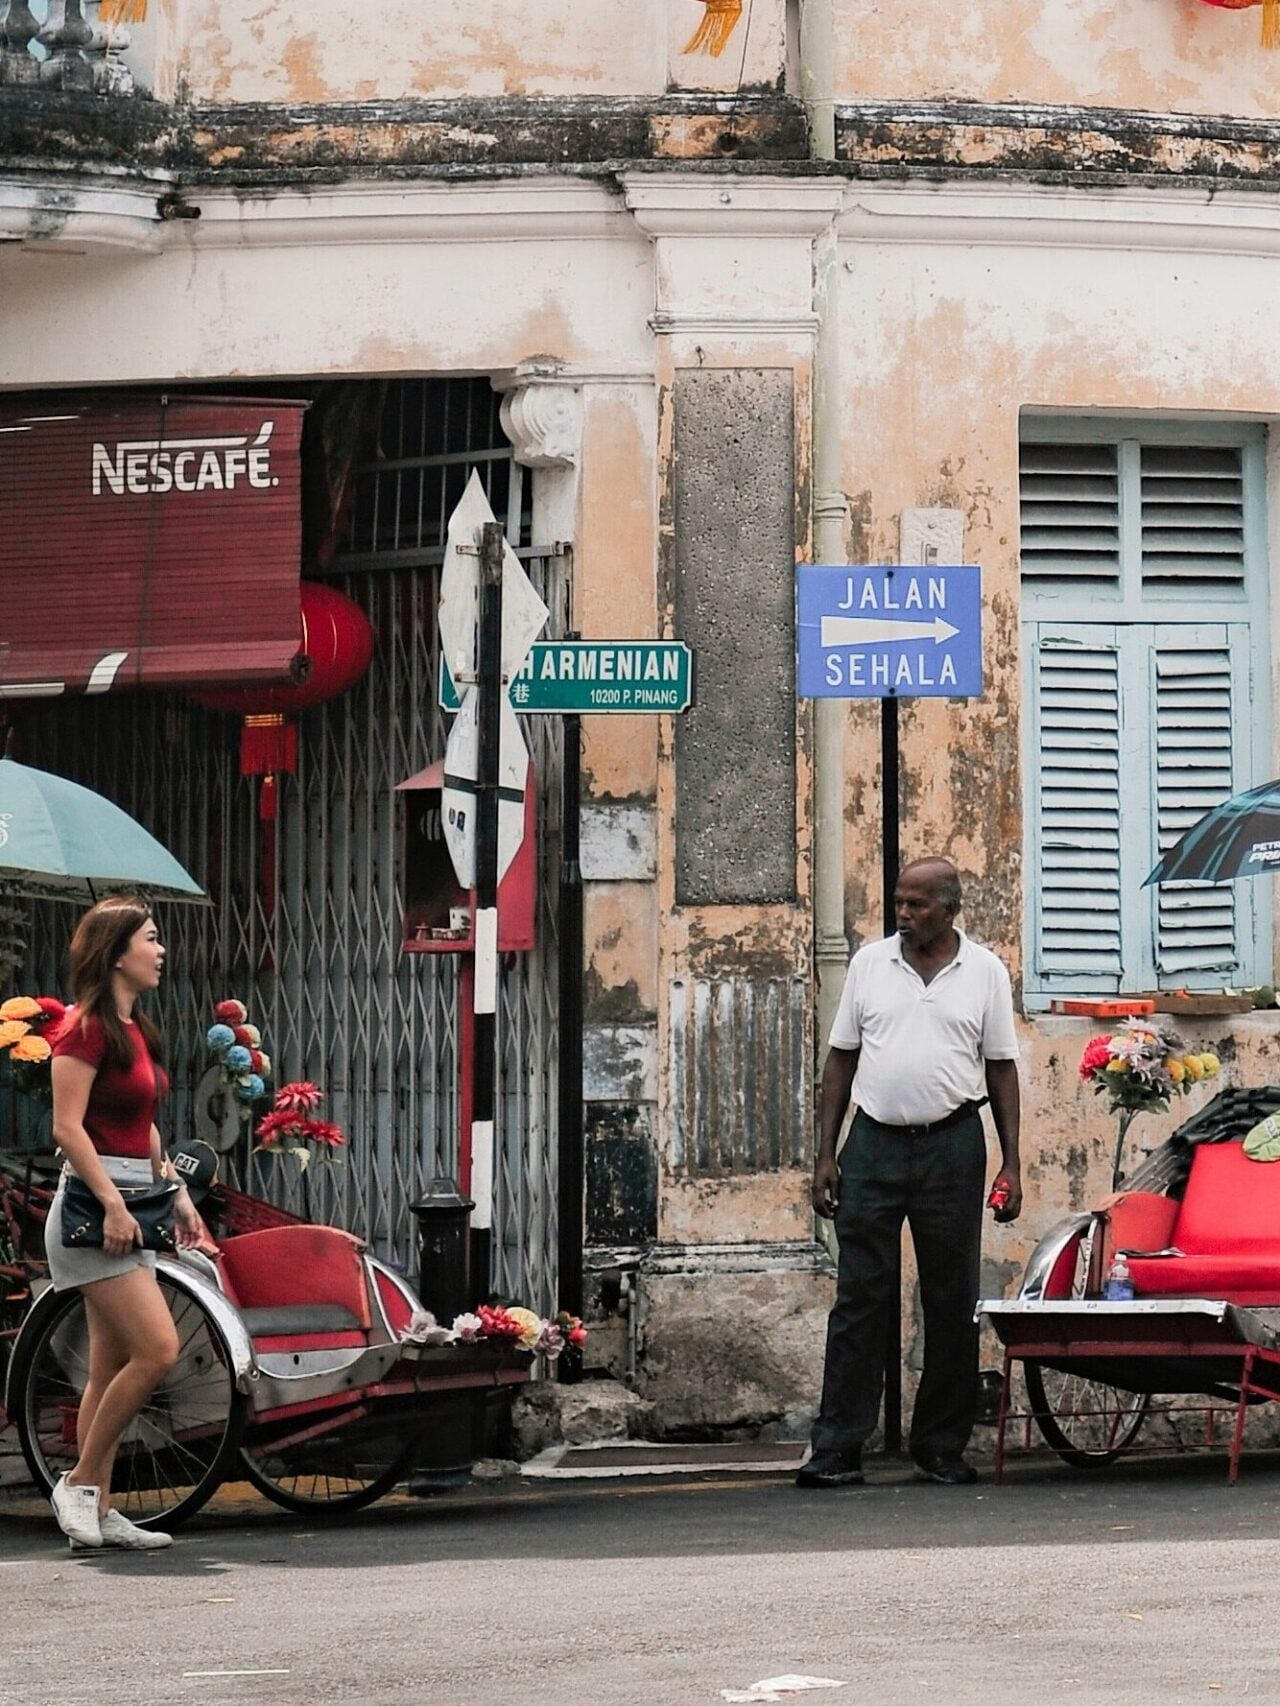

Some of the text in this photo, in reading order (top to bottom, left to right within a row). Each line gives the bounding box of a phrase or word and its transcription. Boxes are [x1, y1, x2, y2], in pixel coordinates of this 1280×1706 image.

[838, 578, 946, 609] JALAN
[540, 650, 679, 681] ARMENIAN
[825, 654, 957, 686] SEHALA
[590, 689, 678, 705] 10200 P. PINANG
[175, 1155, 197, 1171] CAT
